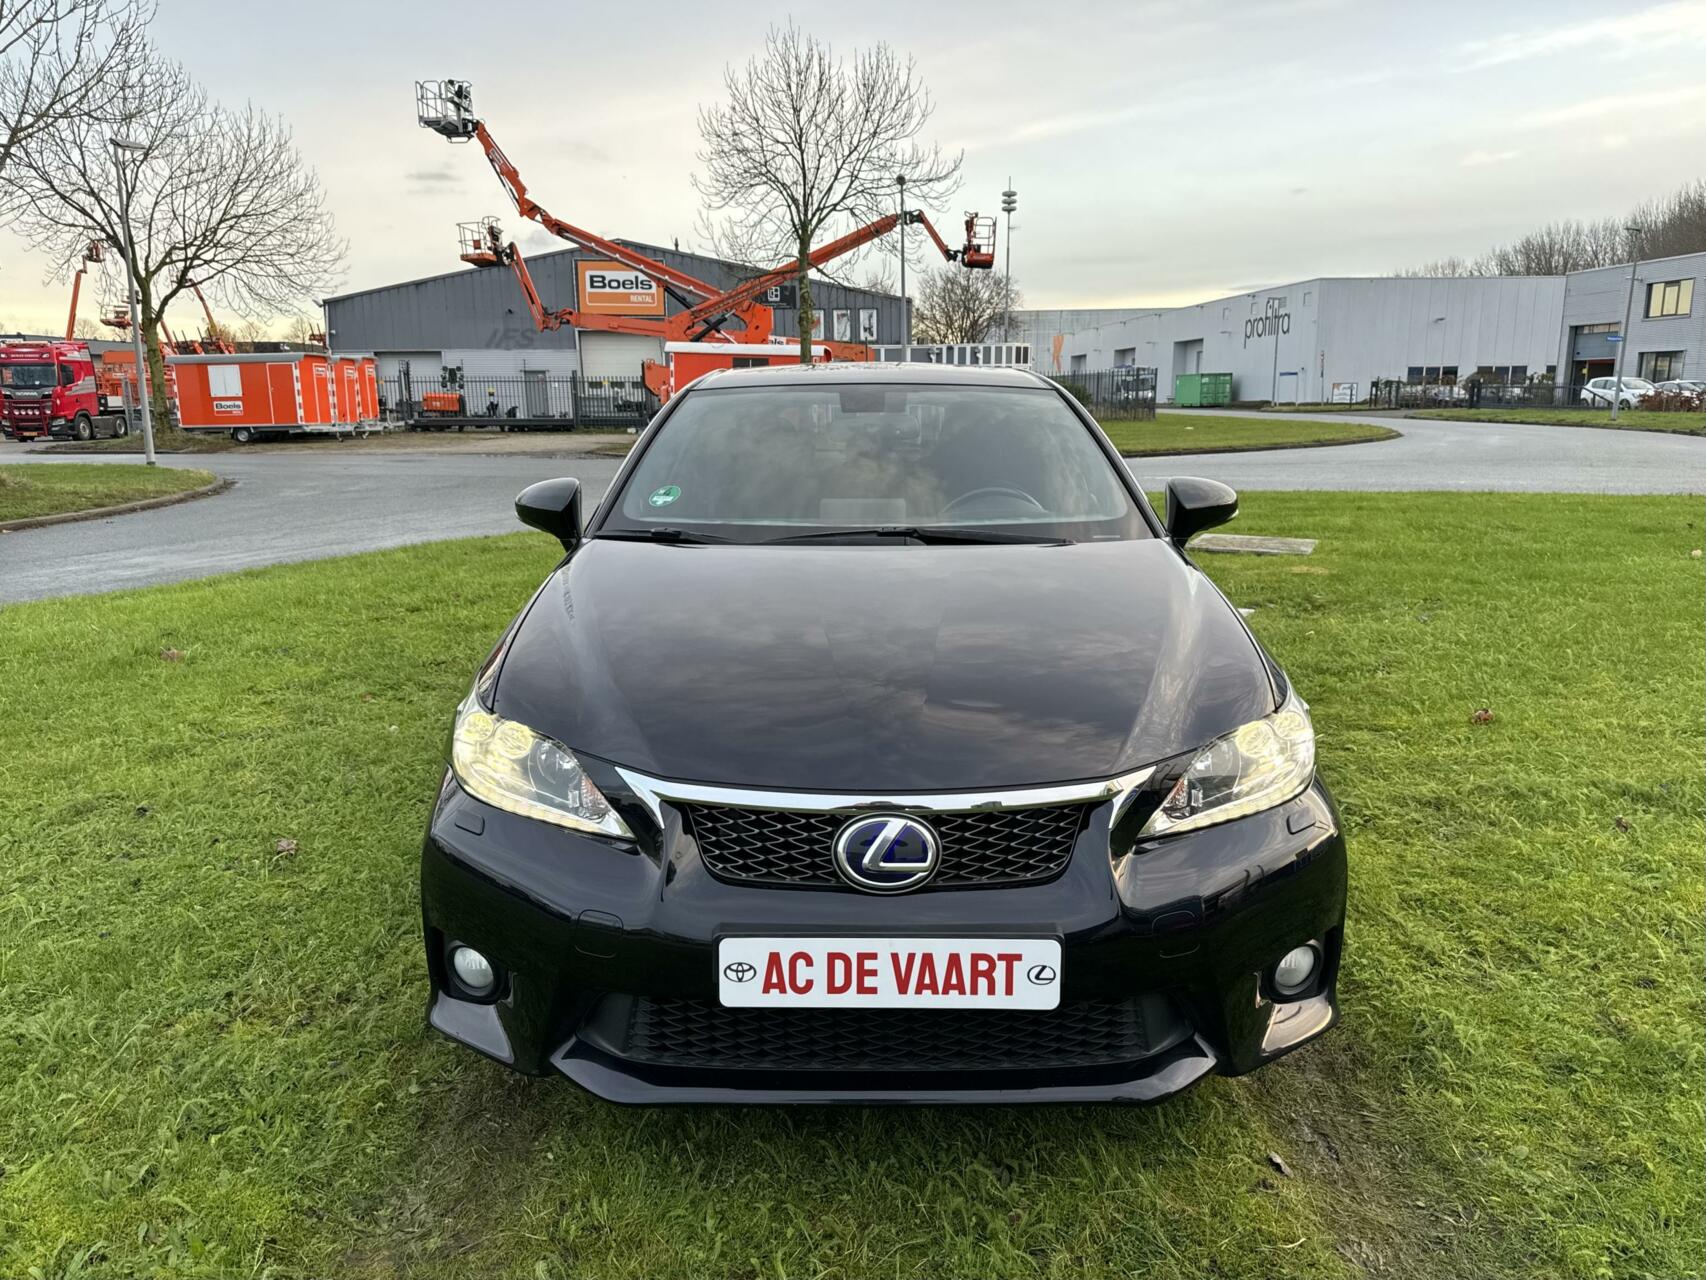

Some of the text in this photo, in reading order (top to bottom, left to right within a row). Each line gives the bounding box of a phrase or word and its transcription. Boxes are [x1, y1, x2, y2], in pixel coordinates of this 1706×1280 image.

[589, 275, 653, 290] Boels
[630, 294, 654, 303] RENTAL
[1243, 298, 1291, 350] profiltra
[762, 951, 1023, 996] AC DE VAART
